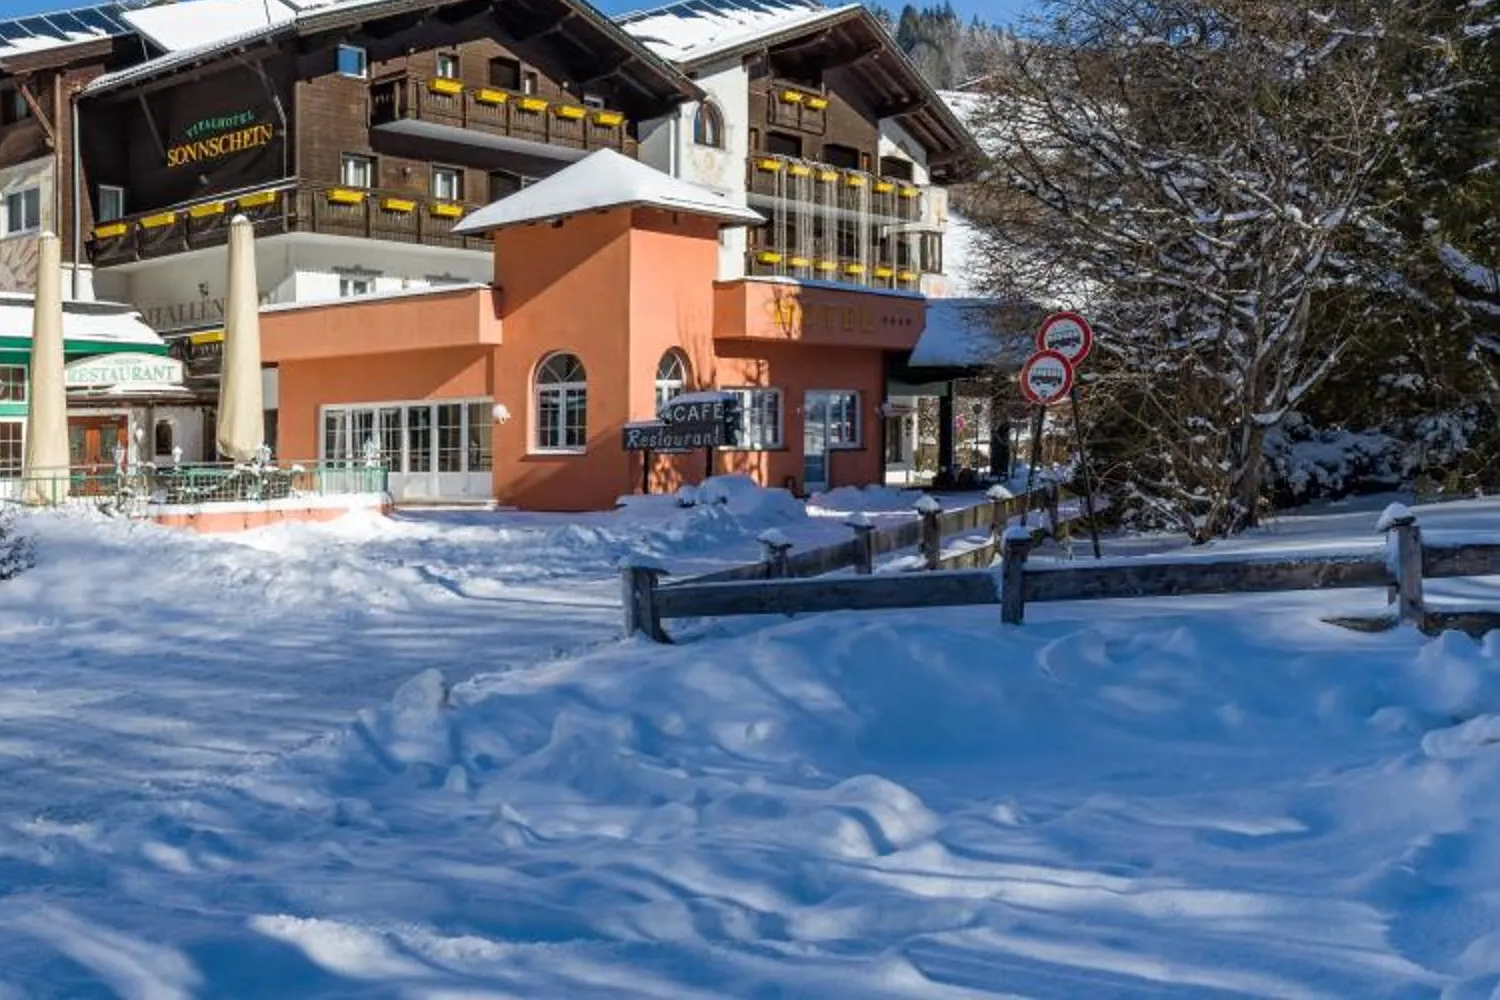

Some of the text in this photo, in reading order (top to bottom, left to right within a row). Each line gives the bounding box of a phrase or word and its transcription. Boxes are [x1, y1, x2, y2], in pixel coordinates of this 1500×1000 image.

[167, 123, 273, 167] SONNSCHEIN
[68, 364, 175, 382] RESTAURANT
[627, 424, 720, 449] Restaurant
